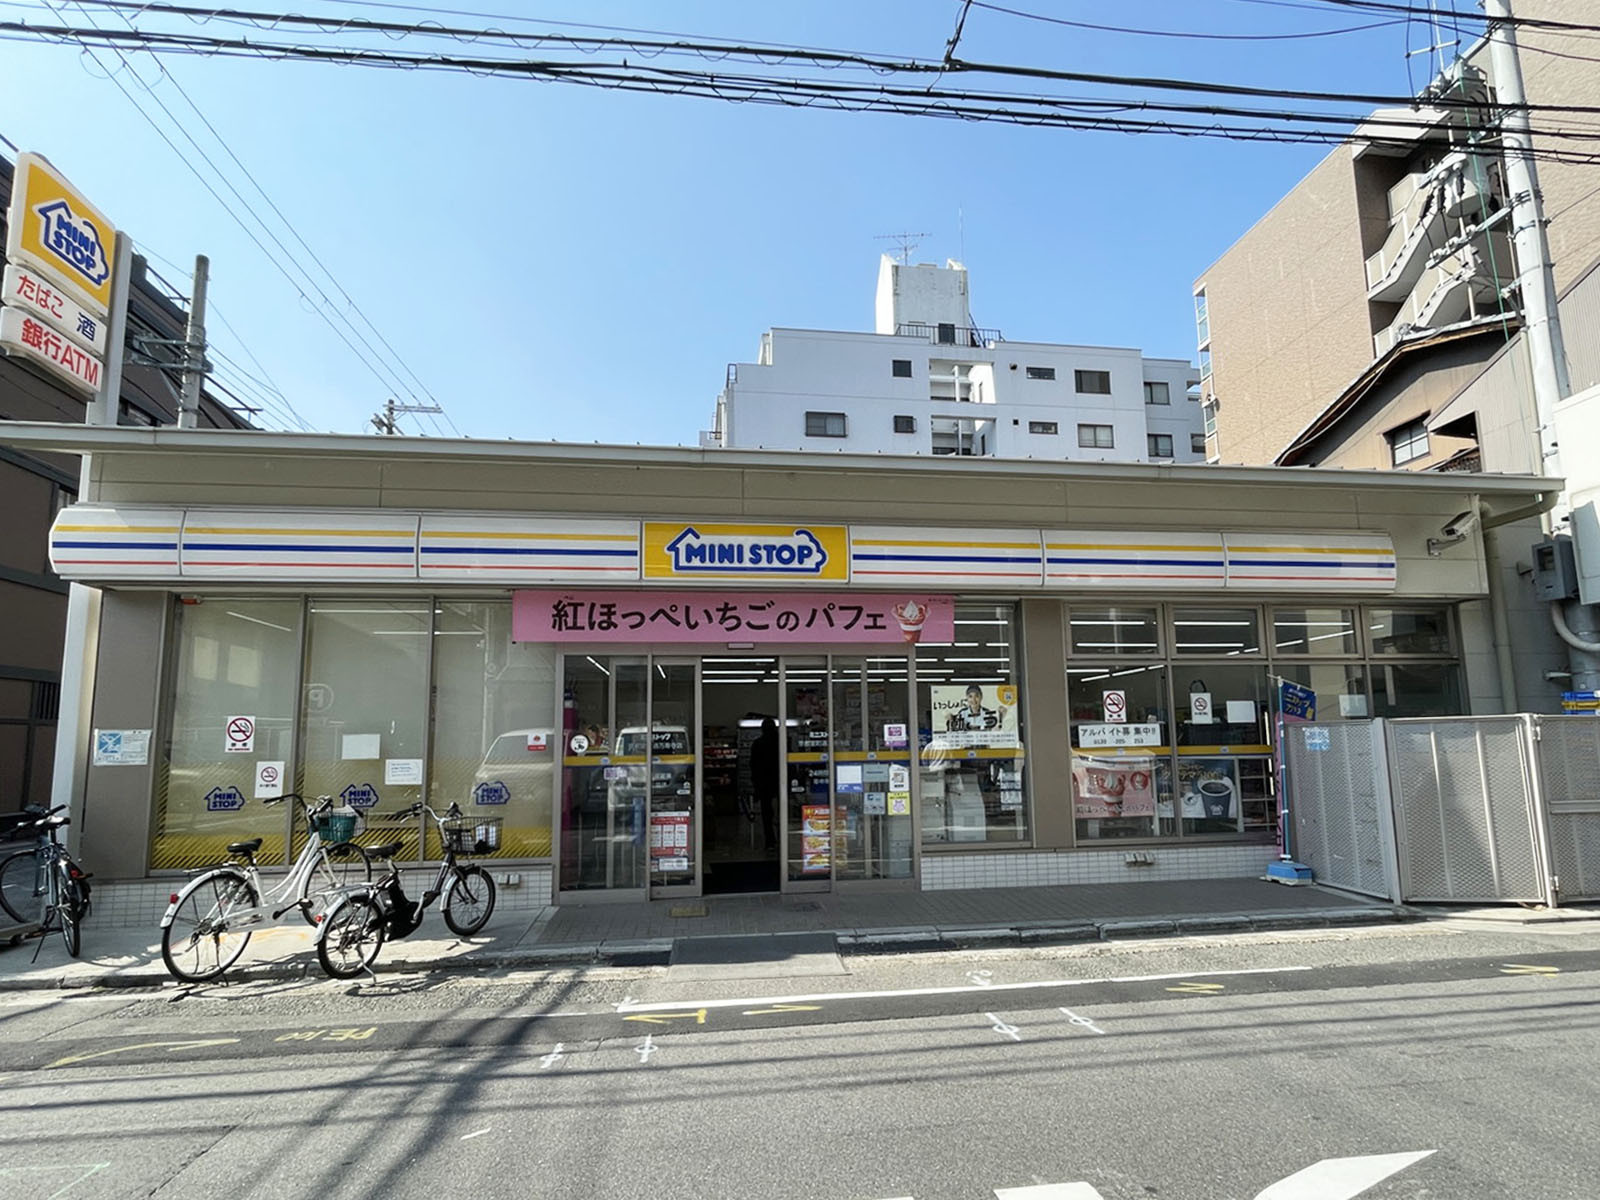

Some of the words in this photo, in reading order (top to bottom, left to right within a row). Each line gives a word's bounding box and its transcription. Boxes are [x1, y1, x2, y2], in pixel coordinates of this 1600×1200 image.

[53, 231, 97, 271] STOP
[57, 214, 96, 255] MINI
[16, 275, 65, 319] たばこ
[76, 312, 97, 342] 酒
[21, 318, 98, 386] 銀行ATM
[685, 543, 743, 564] MINI
[749, 544, 813, 565] STOP
[552, 600, 887, 632] 紅ほっぺいちごのパフェ
[212, 800, 238, 808] STOP
[347, 797, 371, 805] STOP
